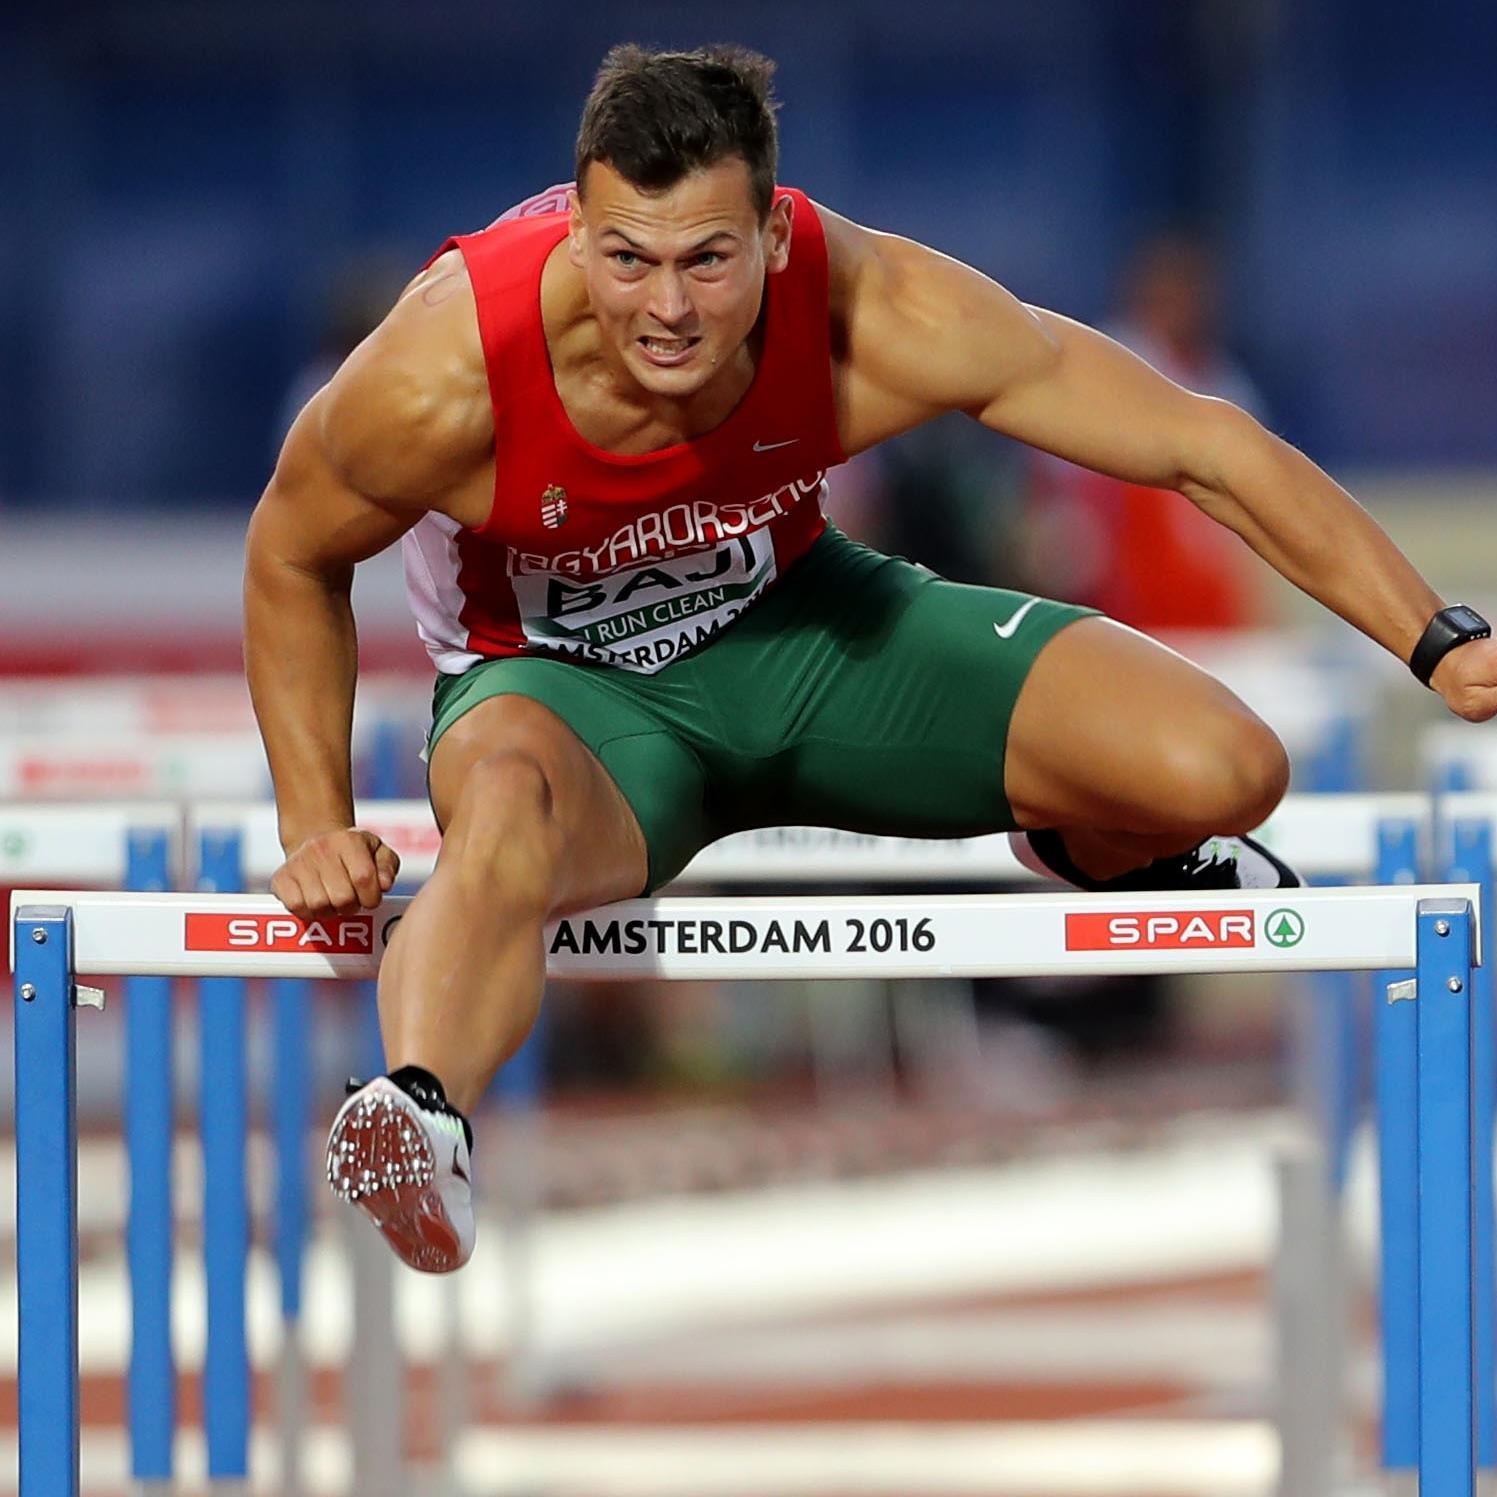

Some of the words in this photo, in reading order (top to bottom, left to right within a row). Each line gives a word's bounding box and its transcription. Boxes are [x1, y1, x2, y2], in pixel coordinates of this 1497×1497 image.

[597, 611, 648, 643] RUN
[652, 587, 725, 623] CLEAN
[227, 919, 370, 947] SPAR
[549, 919, 832, 954] AMSTERDAM
[846, 917, 936, 953] 2016
[1109, 916, 1253, 945] SPAR
